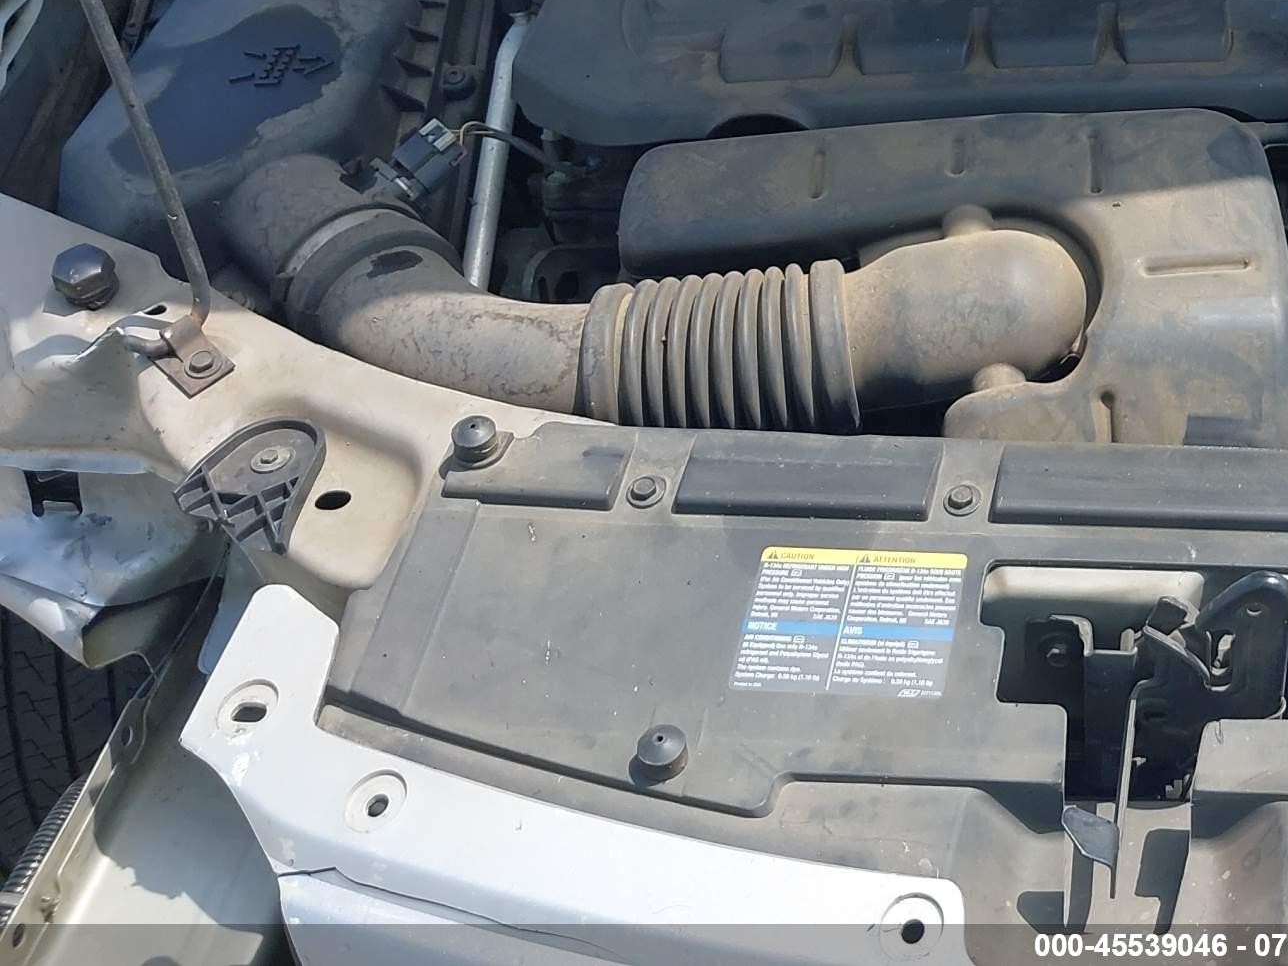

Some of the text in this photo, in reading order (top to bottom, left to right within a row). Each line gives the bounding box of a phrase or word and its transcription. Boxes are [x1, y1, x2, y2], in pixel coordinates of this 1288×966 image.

[780, 552, 815, 561] CAUTION
[873, 554, 917, 564] ATTENTION
[747, 621, 778, 631] NOTICE
[842, 626, 863, 635] AVIS
